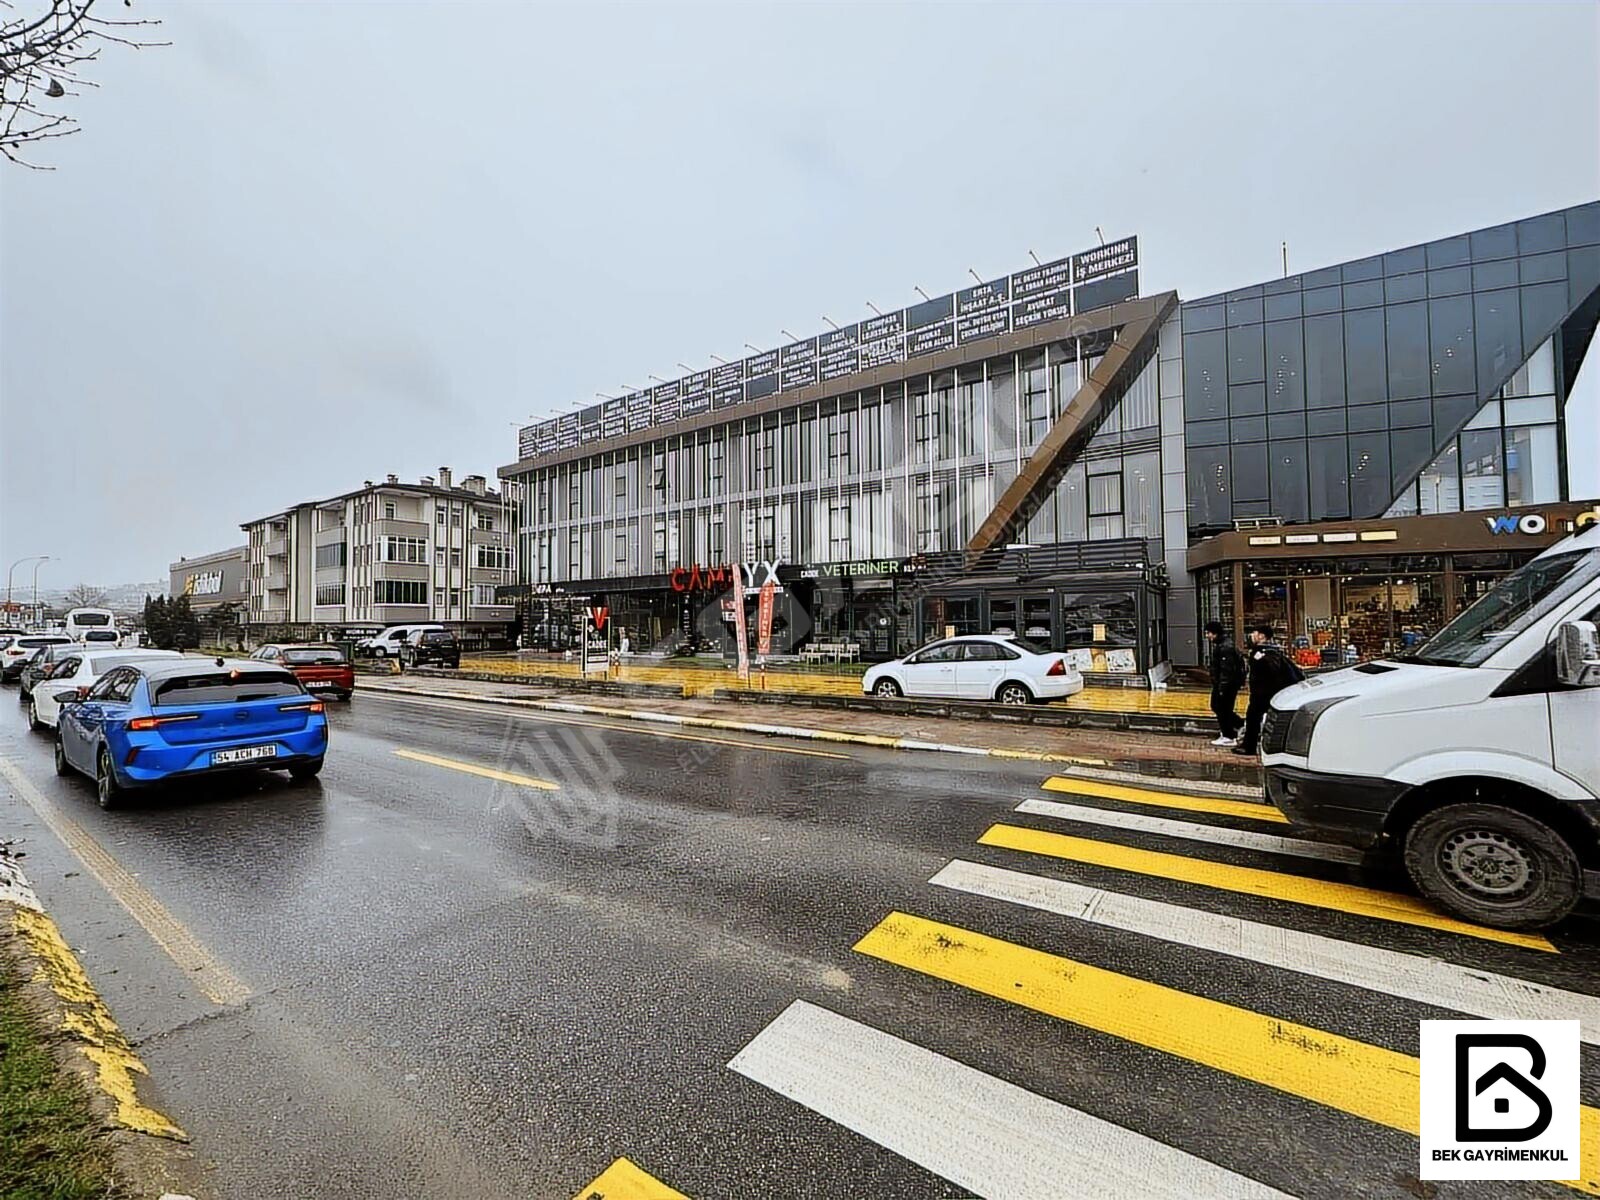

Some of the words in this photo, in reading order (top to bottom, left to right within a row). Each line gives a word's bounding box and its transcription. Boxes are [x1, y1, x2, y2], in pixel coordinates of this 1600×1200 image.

[1080, 241, 1129, 264] WORKINN
[1076, 266, 1087, 279] İŞ
[1088, 250, 1134, 274] MERKEZİ
[961, 298, 987, 313] İNŞAAT
[1027, 297, 1055, 312] AVUKAT
[672, 559, 781, 592] CAMYX
[823, 561, 899, 577] VETERİNER
[217, 751, 229, 762] 54
